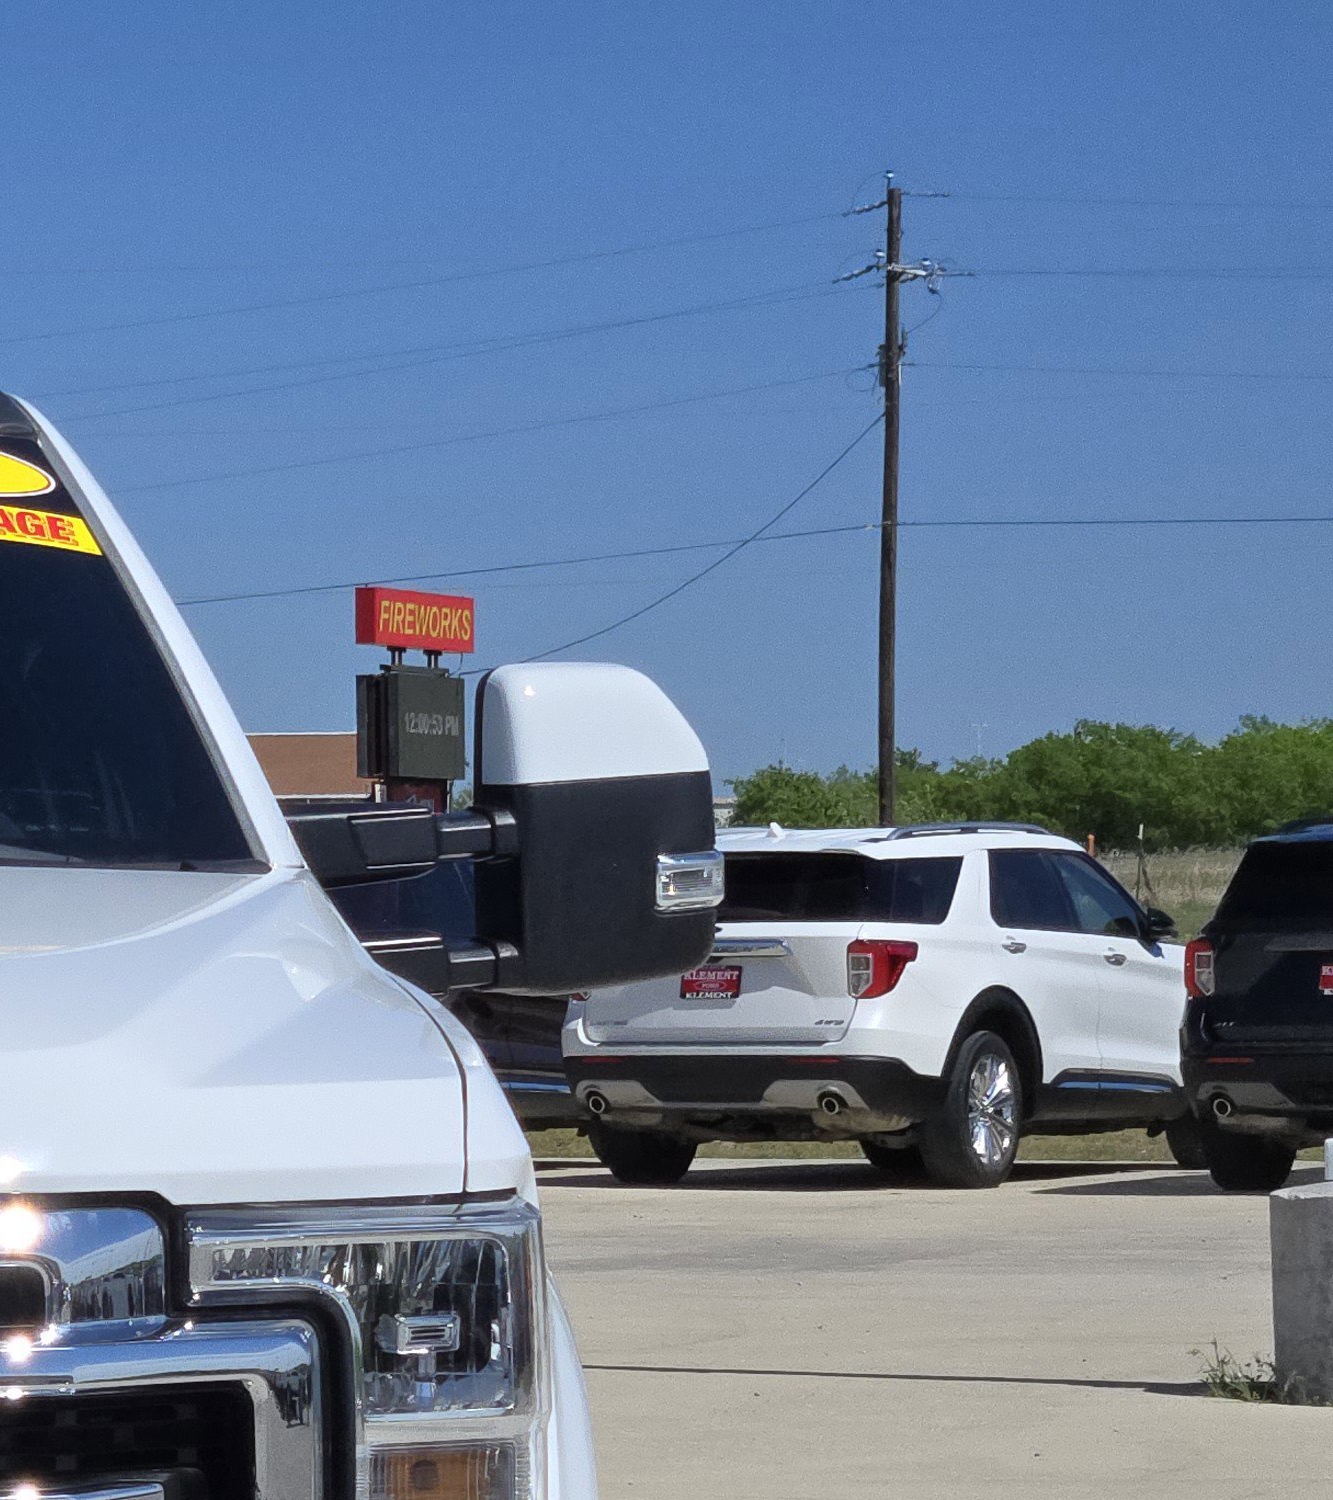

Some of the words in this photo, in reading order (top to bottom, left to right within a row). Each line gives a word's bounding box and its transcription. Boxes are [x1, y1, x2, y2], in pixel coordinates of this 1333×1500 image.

[379, 600, 471, 641] FIREWORKS
[683, 969, 740, 980] KLEMENT
[685, 991, 733, 999] KLEMENT
